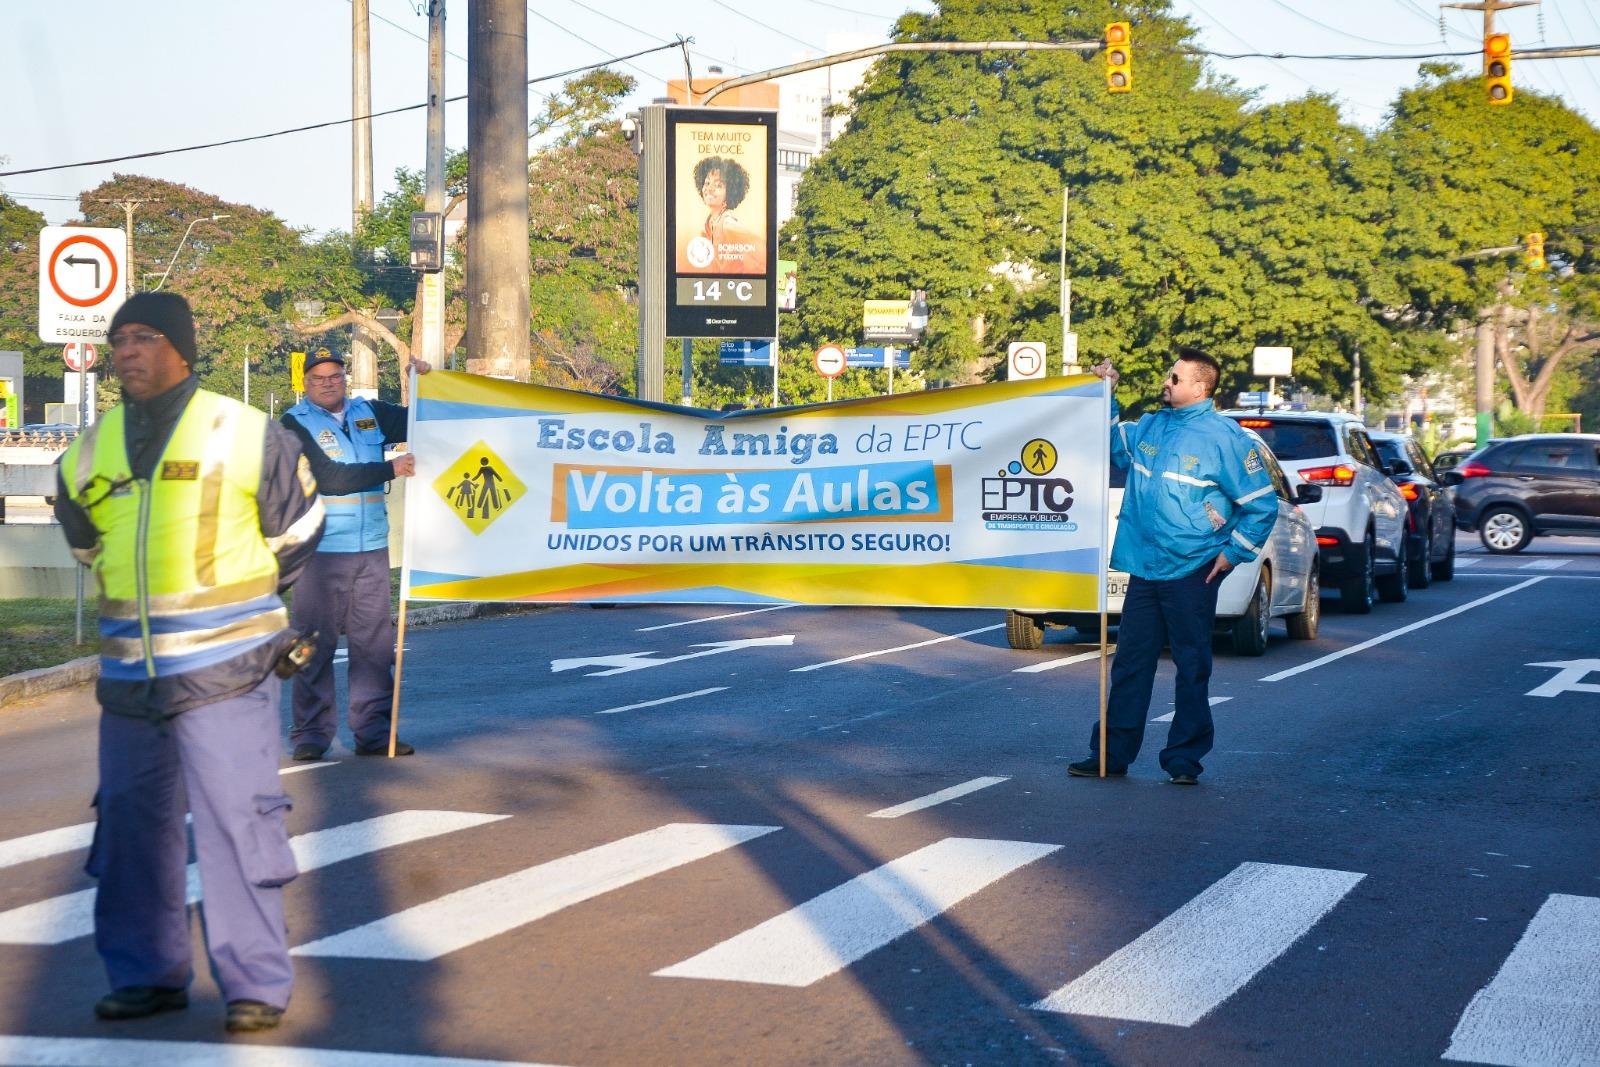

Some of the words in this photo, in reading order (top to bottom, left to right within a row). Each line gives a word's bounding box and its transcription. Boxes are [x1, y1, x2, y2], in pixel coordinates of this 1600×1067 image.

[691, 131, 714, 141] TEM
[716, 131, 752, 142] MUITO
[698, 144, 711, 154] DE
[693, 280, 722, 302] 14
[56, 313, 86, 322] FAIXA
[92, 314, 107, 323] DA
[56, 328, 110, 338] ESQUERDA
[536, 418, 676, 455] Escola
[698, 424, 839, 465] Amiga
[855, 424, 893, 454] da
[903, 420, 983, 452] EPTC
[569, 469, 703, 514] Volta
[716, 472, 771, 514] às
[782, 468, 931, 513] Aulas
[981, 477, 1075, 513] EPTC
[990, 513, 1029, 522] EMPRESA
[1029, 512, 1063, 522] PÚBLICA
[547, 533, 633, 552] UNIDOS
[638, 534, 683, 552] POR
[689, 535, 726, 552] UM
[731, 531, 845, 552] TRÂNSITO
[851, 533, 951, 552] SEGURO!
